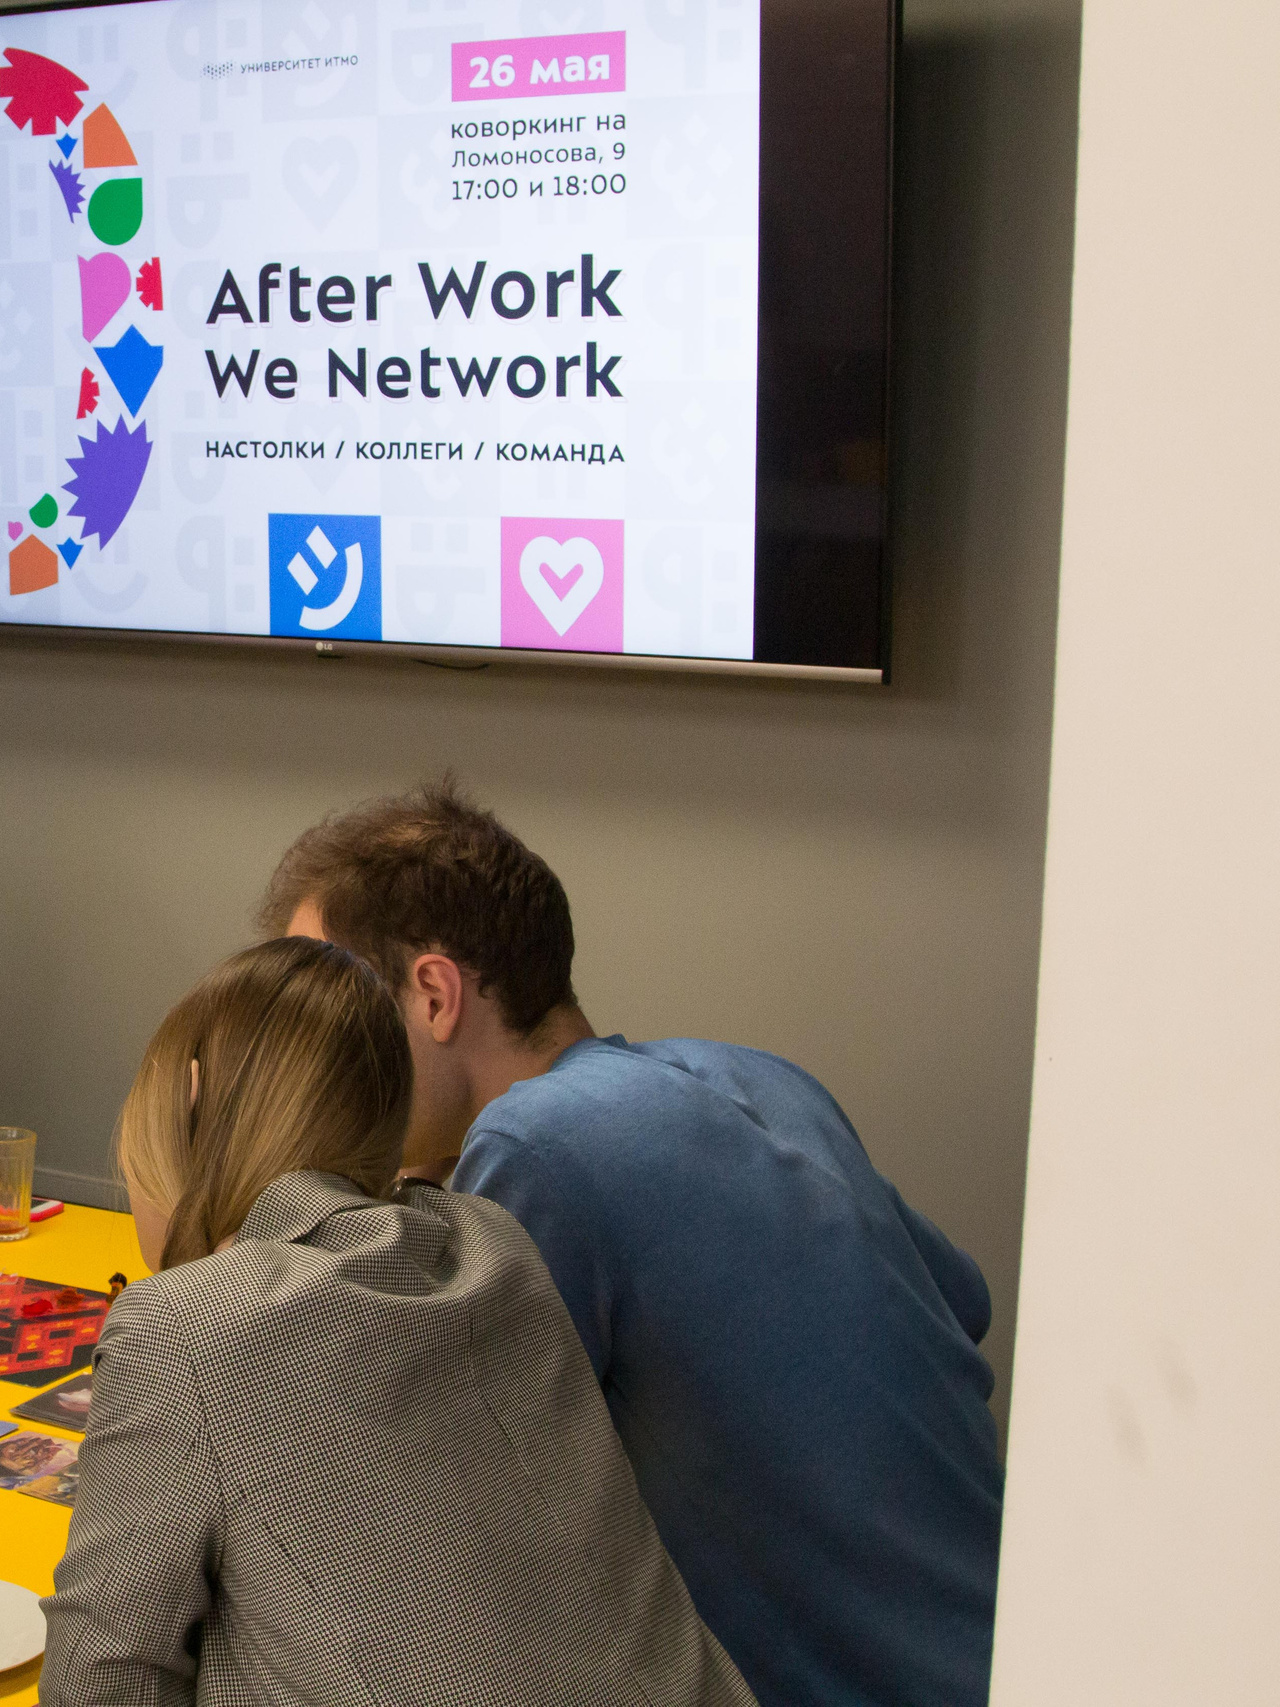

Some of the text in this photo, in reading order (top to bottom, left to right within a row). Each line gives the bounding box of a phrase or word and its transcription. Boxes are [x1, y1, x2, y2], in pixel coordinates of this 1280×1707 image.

[240, 55, 359, 74] УНИВЕРСИТЕТ ИТМО
[468, 54, 610, 88] 26 мая
[451, 114, 626, 141] коворкинг на
[451, 142, 626, 168] Ломоносова, 9
[452, 173, 626, 200] 17:00 и 18:00
[206, 254, 622, 324] After Work
[204, 341, 622, 399] We Network
[206, 440, 325, 459] НАСТОЛКИ
[356, 441, 463, 460] КОЛЛЕГИ
[496, 443, 625, 465] КОМАНДА
